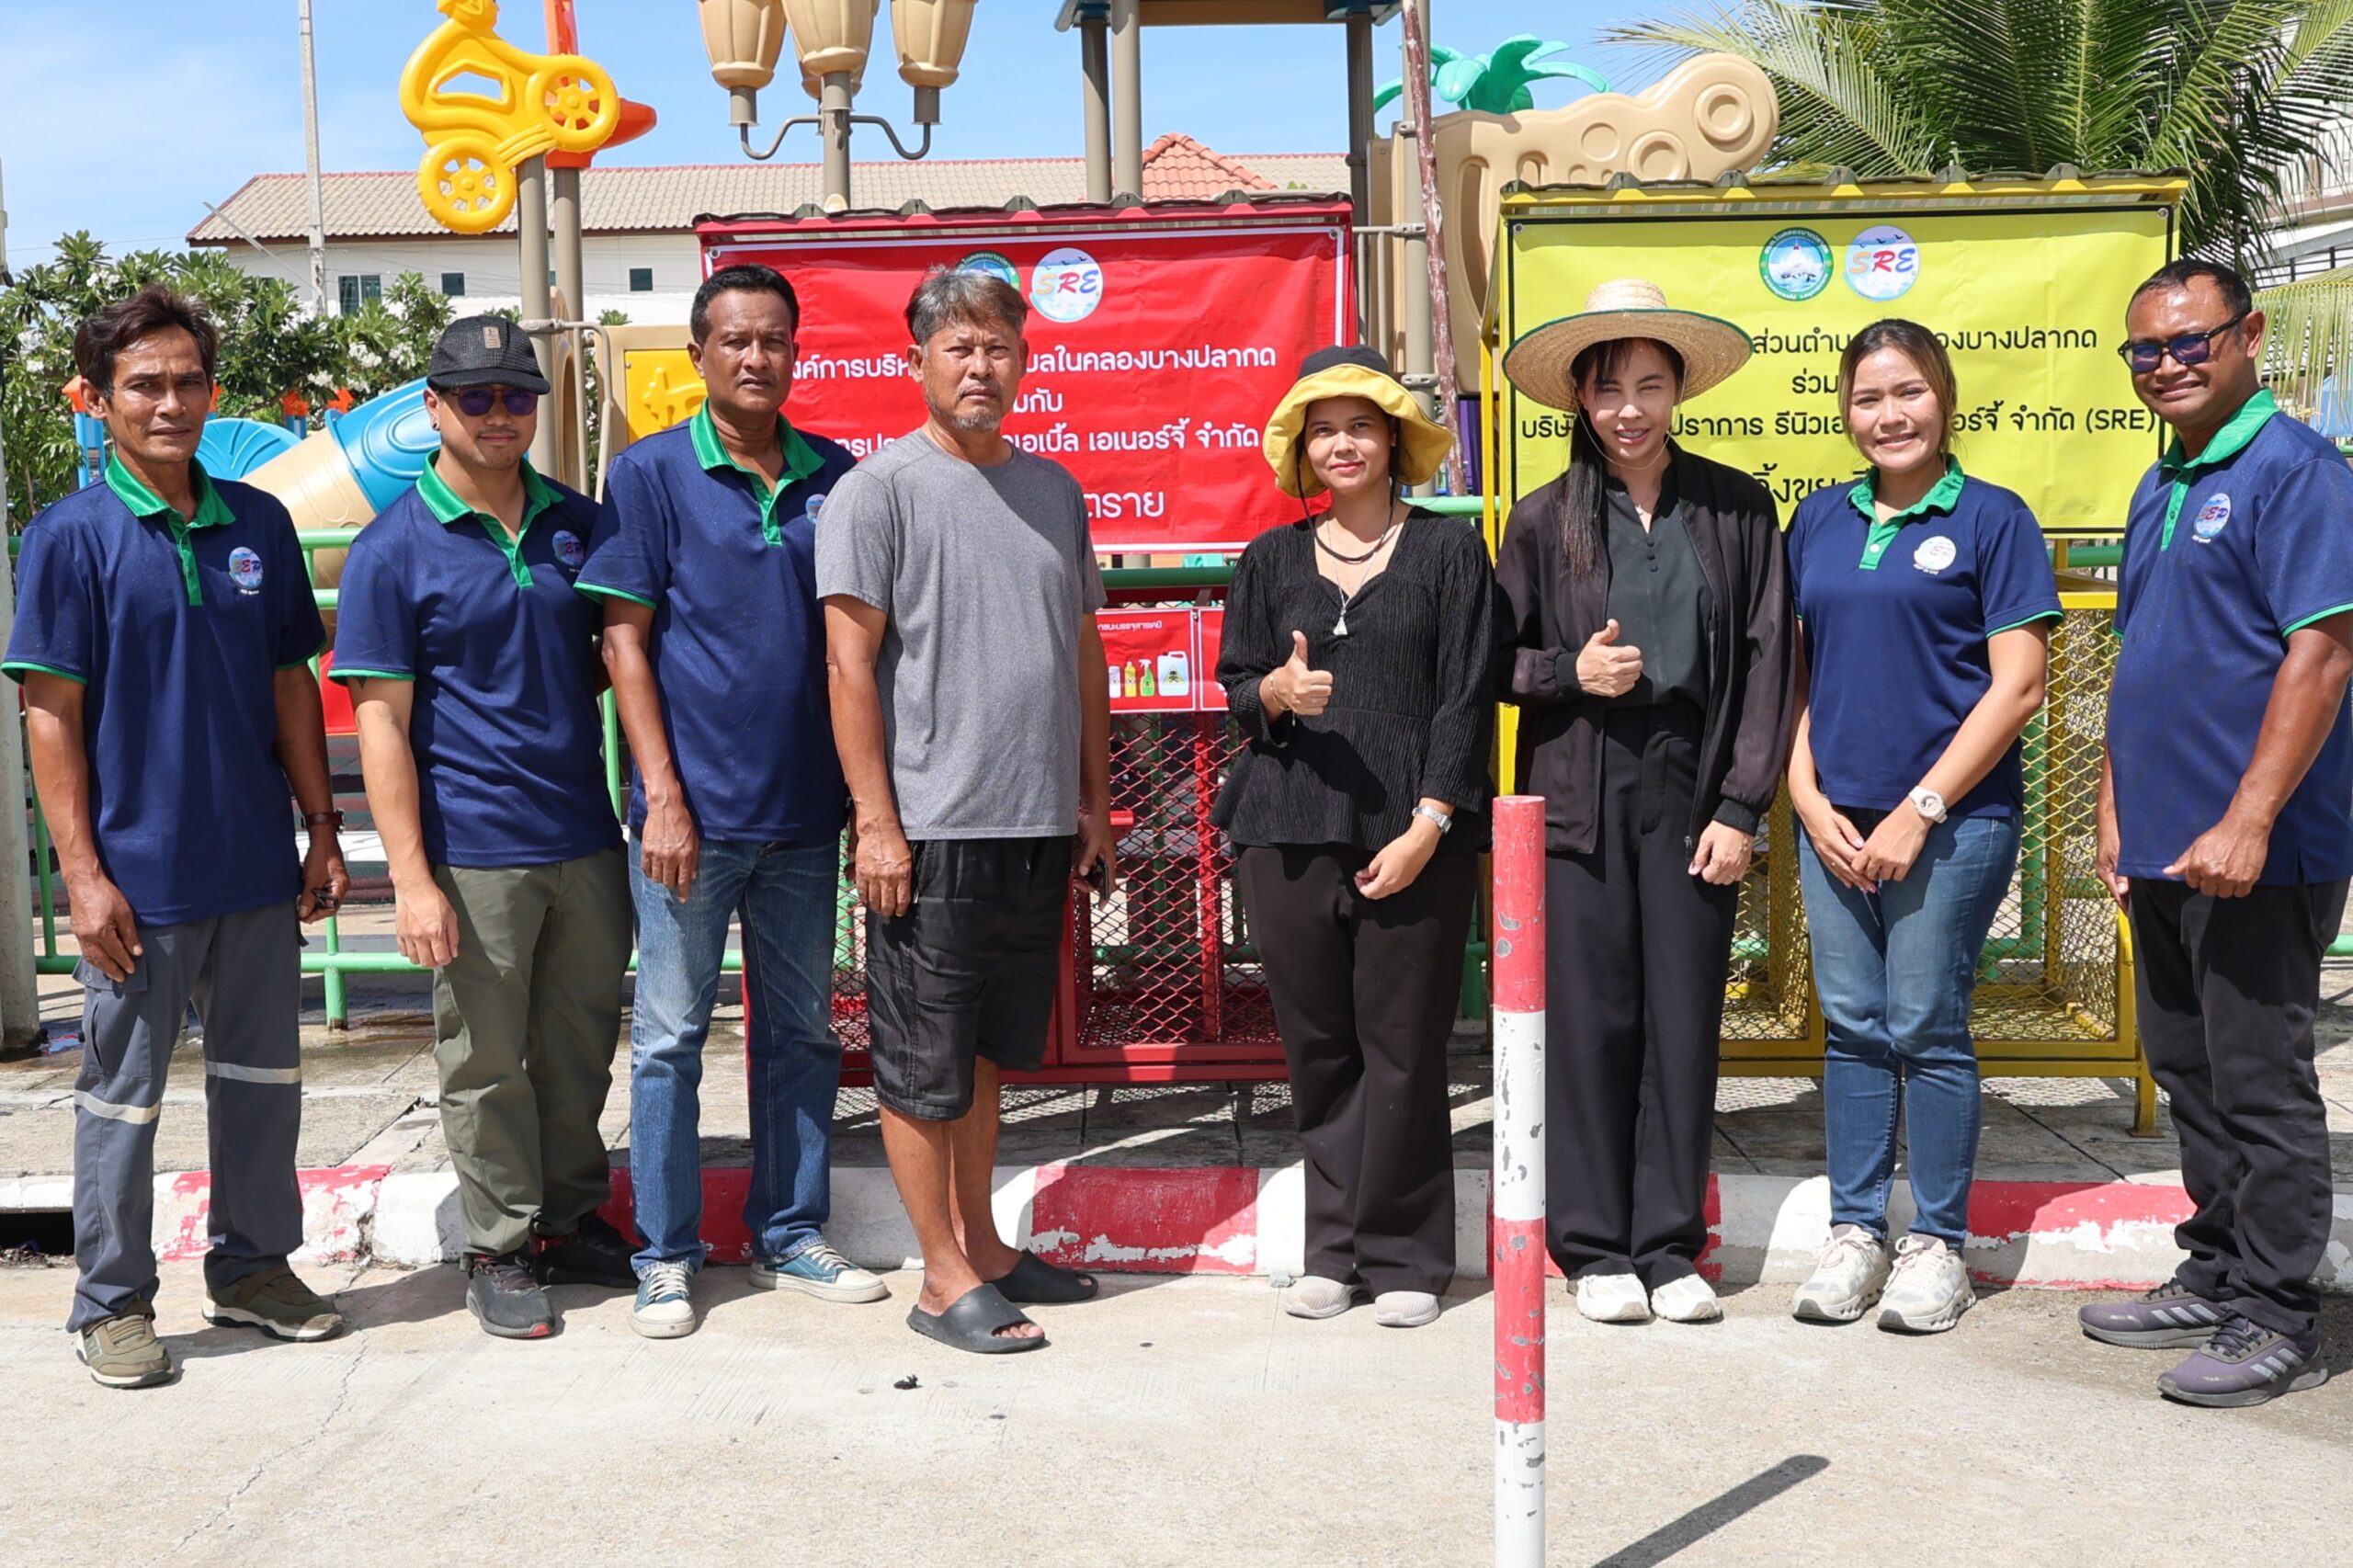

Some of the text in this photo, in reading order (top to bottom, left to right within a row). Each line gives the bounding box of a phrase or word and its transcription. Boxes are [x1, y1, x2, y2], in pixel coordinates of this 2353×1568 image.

[1847, 247, 1915, 275] SRE
[1035, 269, 1099, 296] SRE
[1791, 367, 1839, 394] ร่วม
[2009, 403, 2075, 432] จำกัด
[2086, 407, 2156, 434] (SRE)
[1088, 417, 1191, 451] เอเนอร์จี้
[1195, 421, 1260, 449] จำกัด
